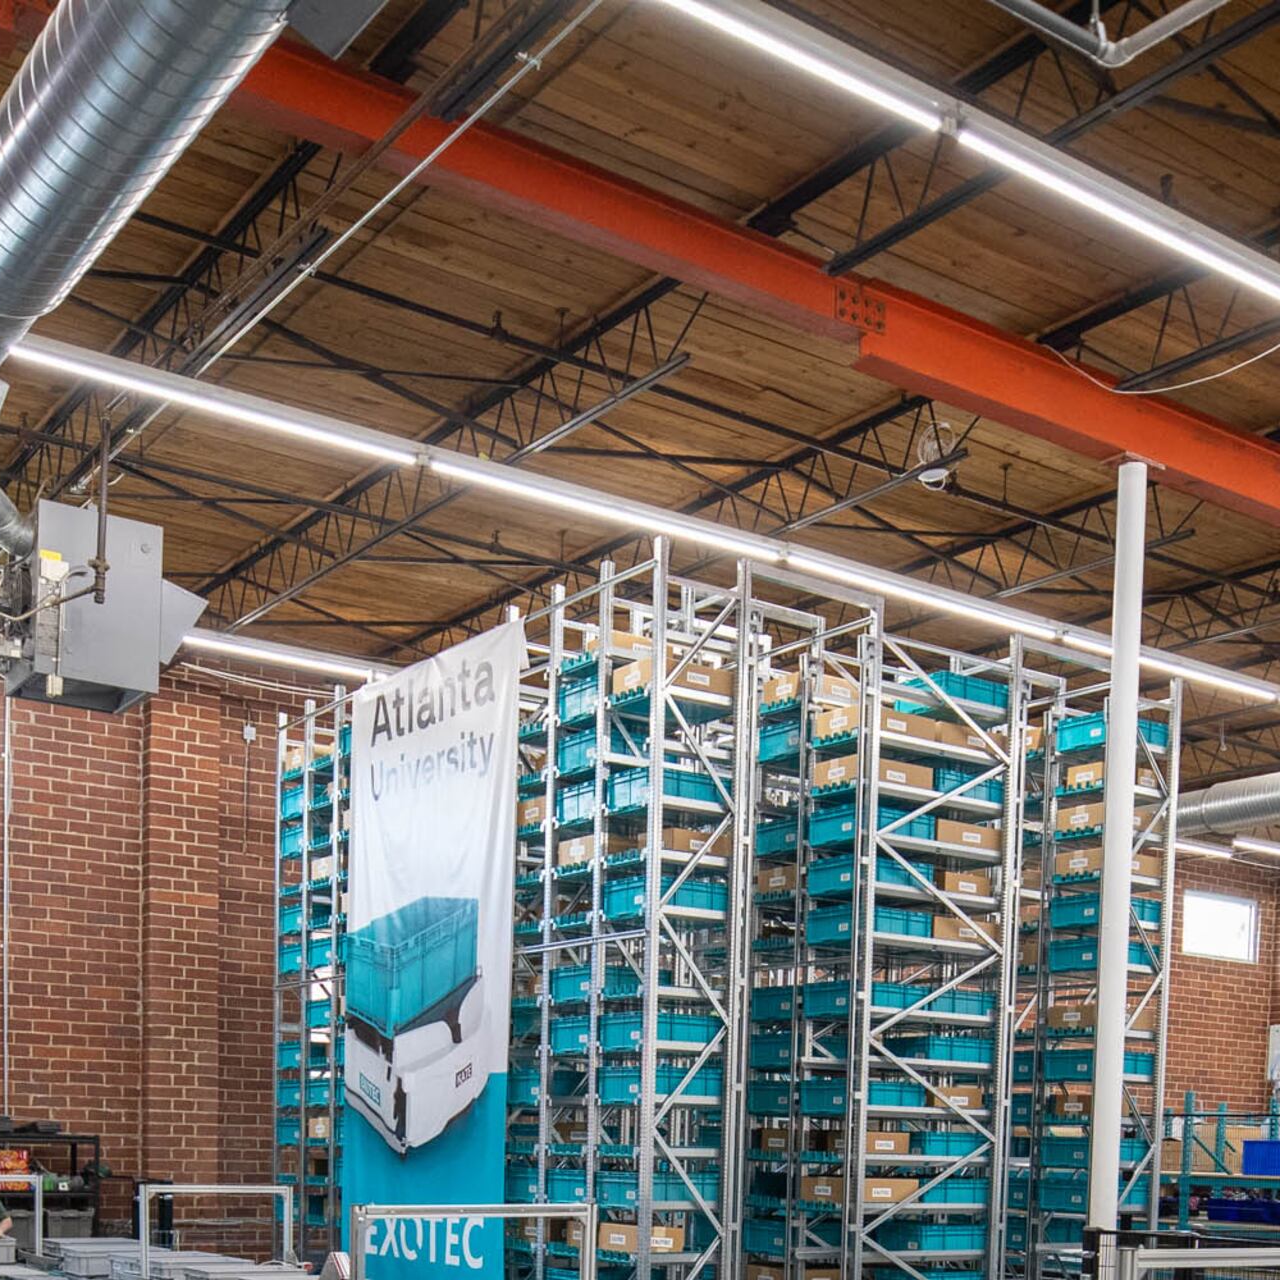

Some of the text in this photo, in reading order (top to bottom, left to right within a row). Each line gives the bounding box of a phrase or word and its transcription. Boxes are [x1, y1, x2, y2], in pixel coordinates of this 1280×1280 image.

[371, 659, 495, 748] Atlanta
[371, 731, 495, 801] University
[365, 1217, 485, 1269] EXOTEC
